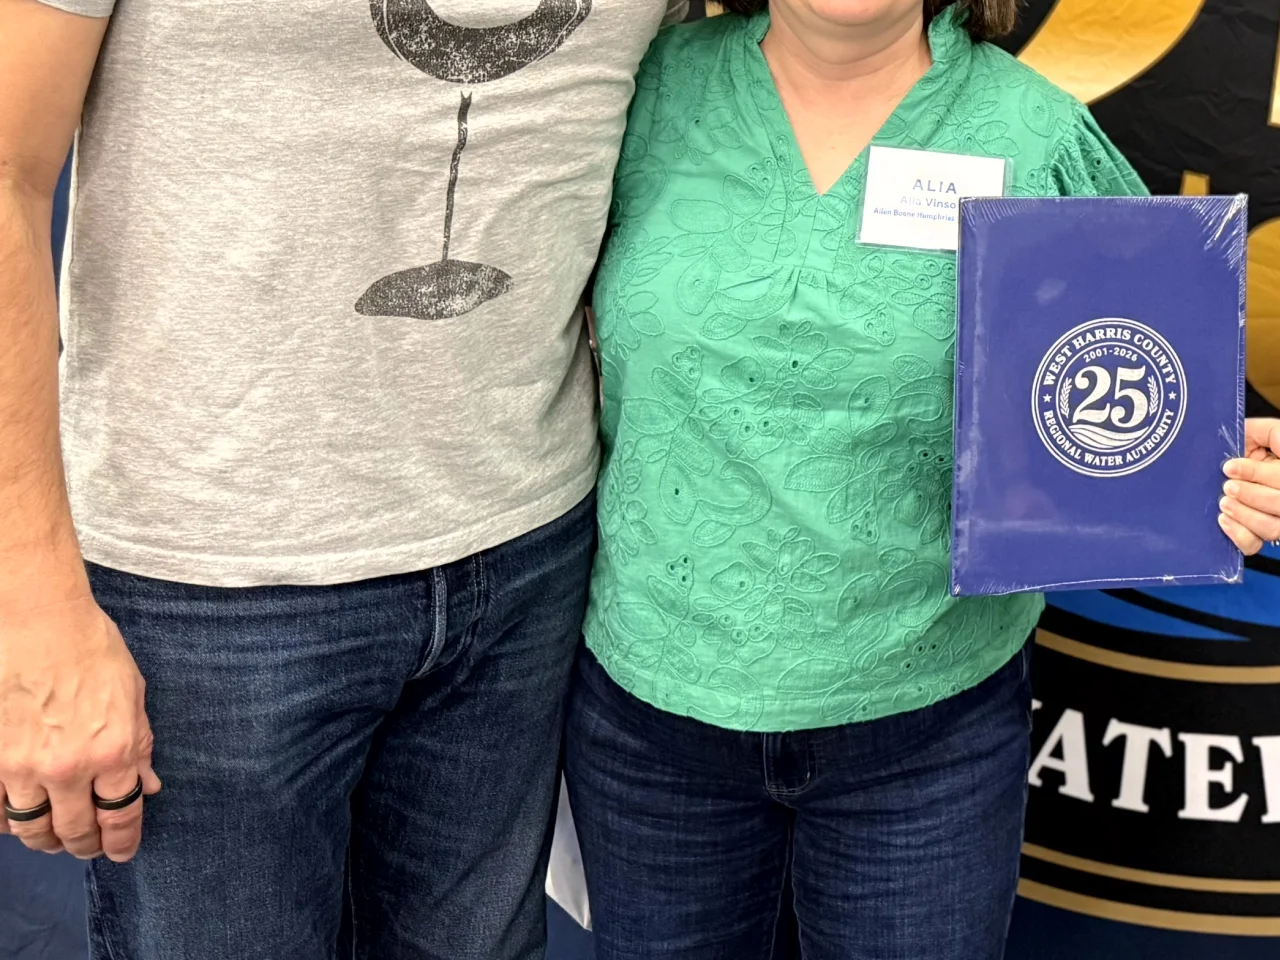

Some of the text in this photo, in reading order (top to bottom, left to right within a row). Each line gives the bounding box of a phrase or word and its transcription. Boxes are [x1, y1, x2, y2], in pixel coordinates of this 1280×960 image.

[912, 178, 958, 195] ALIA
[926, 198, 957, 209] Vinso
[894, 209, 916, 218] Boone
[917, 211, 955, 222] Humphries
[1043, 327, 1177, 386] WEST HARRIS COUNTY
[1083, 347, 1138, 363] 2001-2026
[1072, 365, 1149, 428] 25
[1043, 408, 1175, 467] REGIONAL WATER AUTHORITY
